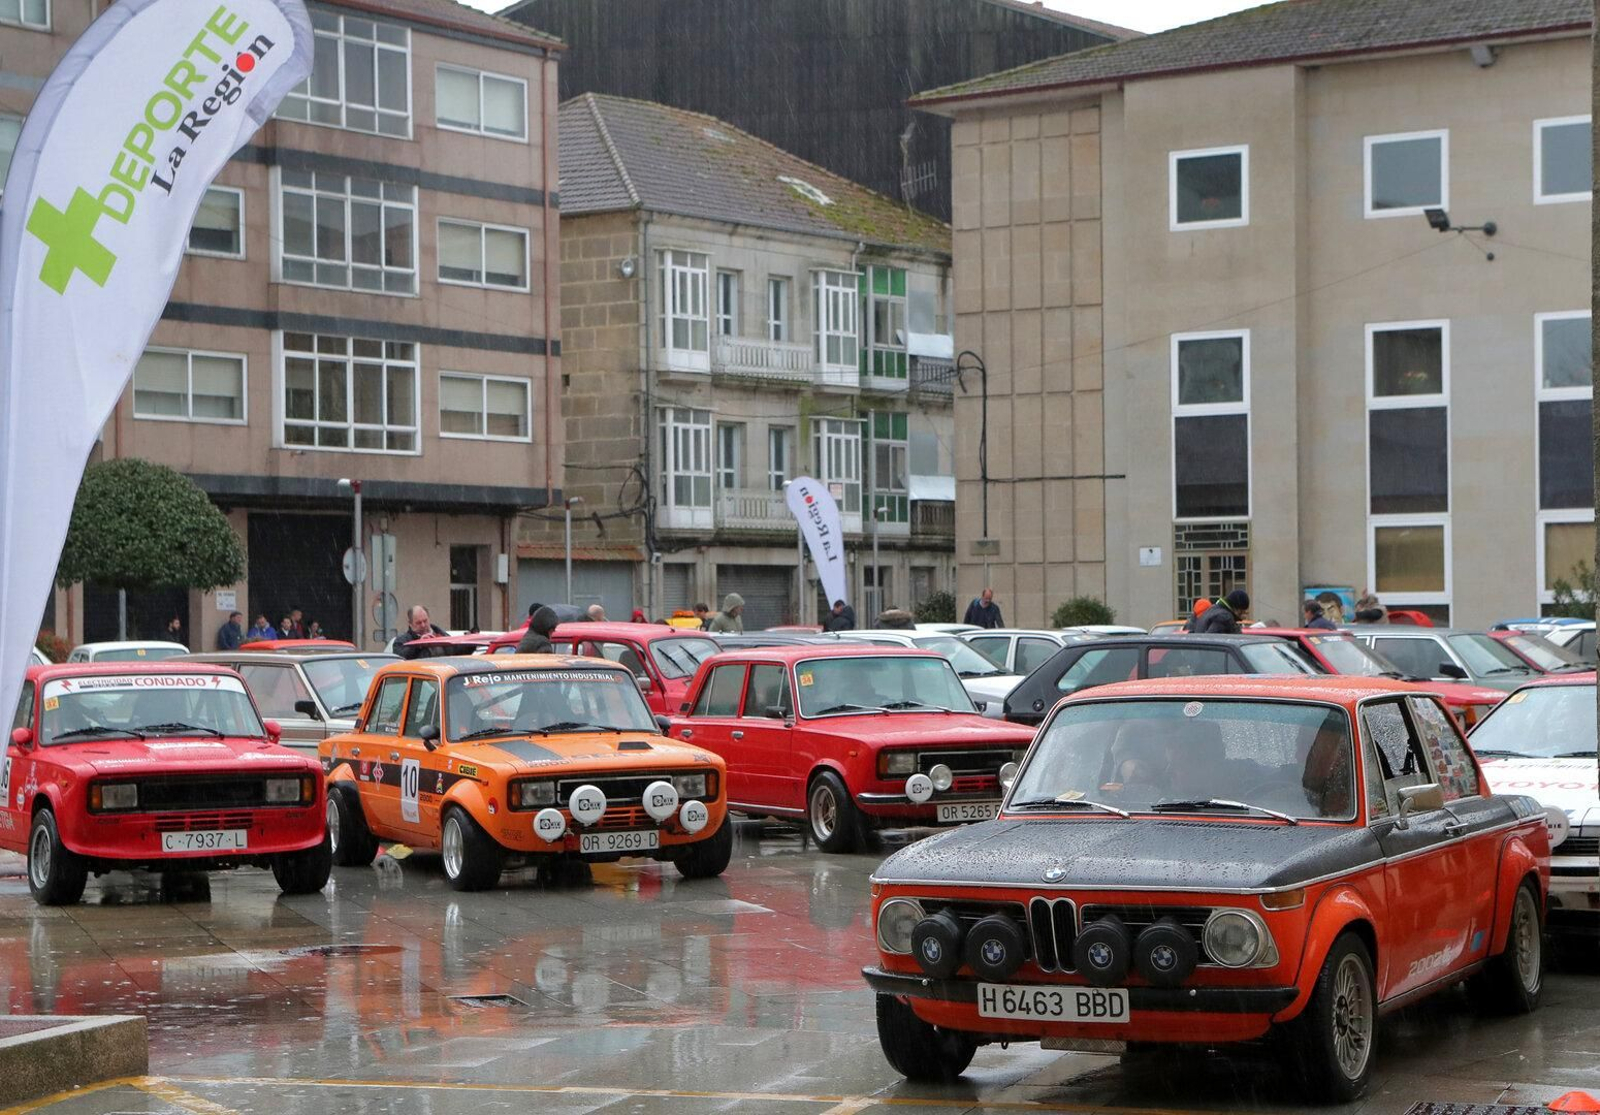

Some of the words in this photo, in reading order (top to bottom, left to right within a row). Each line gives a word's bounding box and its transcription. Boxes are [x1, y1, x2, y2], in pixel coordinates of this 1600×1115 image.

[98, 5, 250, 225] DEPORTE
[150, 146, 187, 197] La
[134, 676, 206, 687] CONDADO
[504, 673, 569, 681] MANTENIMIENTO
[569, 672, 615, 681] INDUSTRIAL
[403, 765, 417, 798] 10
[1490, 781, 1598, 791] TOYO
[942, 806, 958, 819] OR
[961, 804, 991, 818] 5265
[1076, 992, 1125, 1018] BBD
